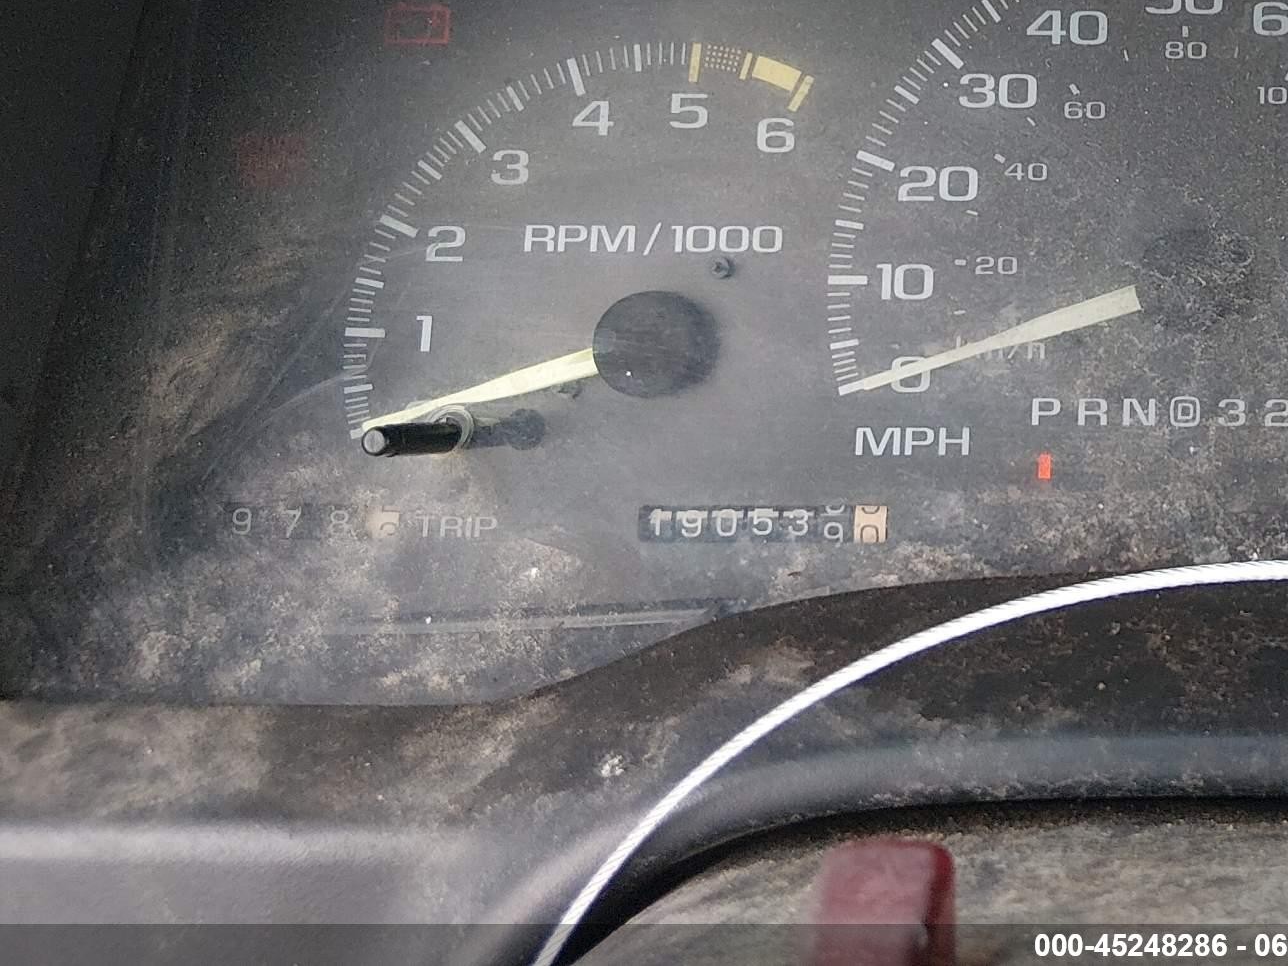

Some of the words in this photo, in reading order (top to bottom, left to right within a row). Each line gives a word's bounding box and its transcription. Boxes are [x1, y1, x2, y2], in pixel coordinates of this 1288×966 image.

[1026, 11, 1109, 45] 40
[1164, 40, 1207, 59] 80
[959, 73, 1038, 108] 30
[572, 100, 614, 136] 4
[669, 93, 709, 129] 5
[1063, 101, 1106, 120] 60
[756, 117, 795, 153] 6
[490, 149, 529, 185] 3
[897, 165, 978, 202] 20
[1004, 162, 1048, 182] 40
[425, 226, 466, 262] 2
[877, 263, 934, 300] 10
[974, 256, 1018, 275] 20
[416, 315, 434, 352] 1
[891, 355, 931, 393] 0
[1031, 397, 1061, 426] P
[1077, 398, 1108, 426] R
[1122, 398, 1156, 426] N
[1218, 398, 1247, 427] 3
[855, 427, 970, 456] MPH
[415, 513, 498, 538] TRIP
